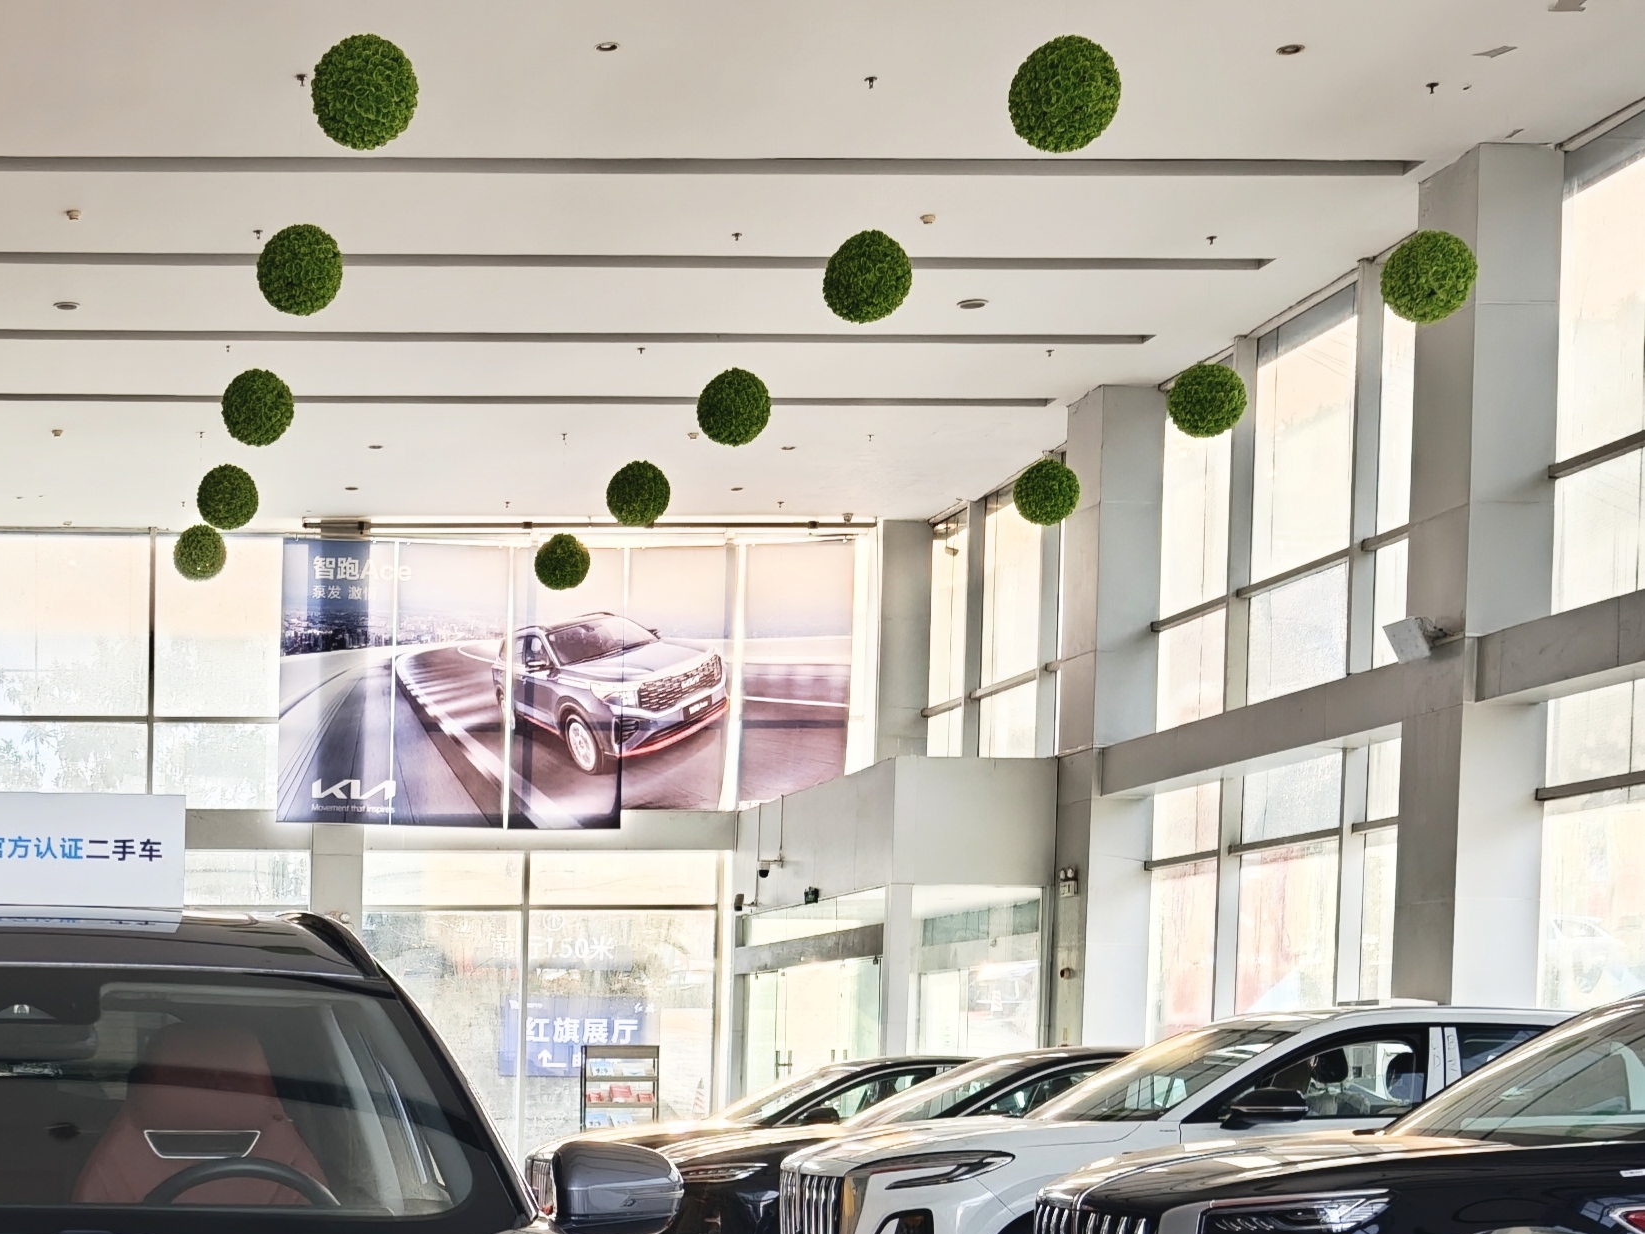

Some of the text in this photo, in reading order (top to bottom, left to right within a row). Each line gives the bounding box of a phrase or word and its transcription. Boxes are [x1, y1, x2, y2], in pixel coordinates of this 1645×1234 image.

[313, 555, 413, 582] 智跑Ace
[312, 585, 342, 600] 泵发
[311, 777, 397, 801] KIA
[310, 803, 350, 812] Movement
[350, 804, 366, 813] that
[526, 1016, 639, 1045] 红旗展厅
